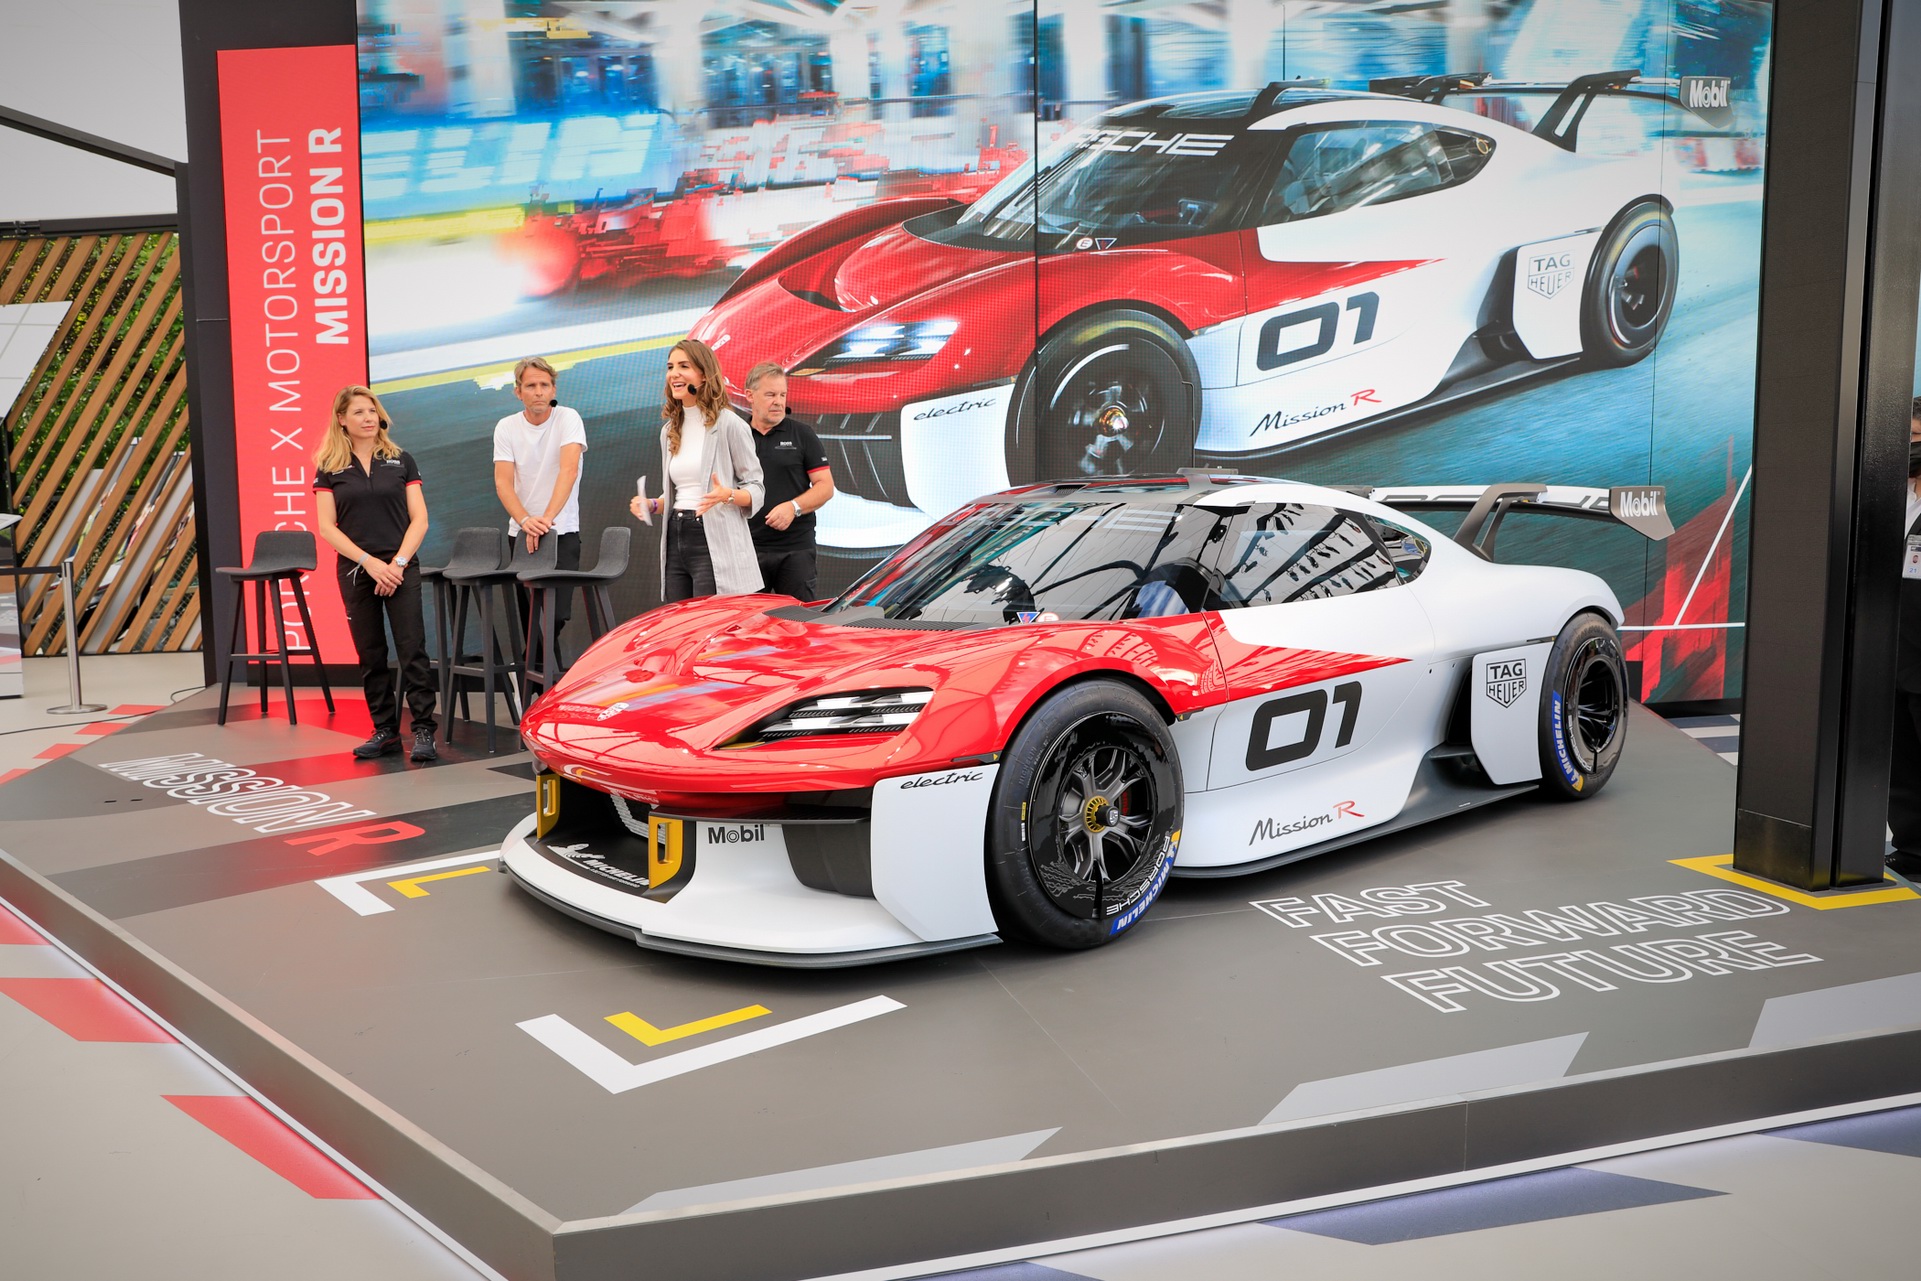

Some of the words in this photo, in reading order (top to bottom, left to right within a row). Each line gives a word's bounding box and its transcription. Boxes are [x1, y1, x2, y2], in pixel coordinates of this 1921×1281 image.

[1690, 80, 1728, 108] Mobil
[307, 127, 342, 153] R
[256, 129, 301, 411] MOTORSPORT
[309, 167, 349, 344] MISSION
[1533, 254, 1570, 271] TAG
[1530, 271, 1571, 295] HEUER
[1256, 291, 1379, 371] 01
[913, 398, 996, 421] electric
[1249, 403, 1346, 438] Mission
[1350, 389, 1382, 406] R
[270, 427, 303, 450] X
[1620, 491, 1659, 517] Mobil
[1488, 680, 1525, 704] HEUER
[1489, 662, 1523, 680] TAG
[1246, 681, 1362, 771] 01
[1553, 700, 1576, 775] MICHELIN
[899, 771, 984, 790] electric
[98, 752, 377, 833] MISSION
[283, 820, 426, 857] R
[1249, 813, 1333, 846] Mission
[1333, 800, 1365, 819] R
[708, 824, 765, 844] Mobil
[1106, 835, 1170, 916] PORSCHE
[1116, 861, 1170, 931] MICHELIN
[1249, 880, 1492, 929] FAST
[1308, 888, 1792, 967] FORWARD
[1379, 930, 1826, 1014] FUTURE
